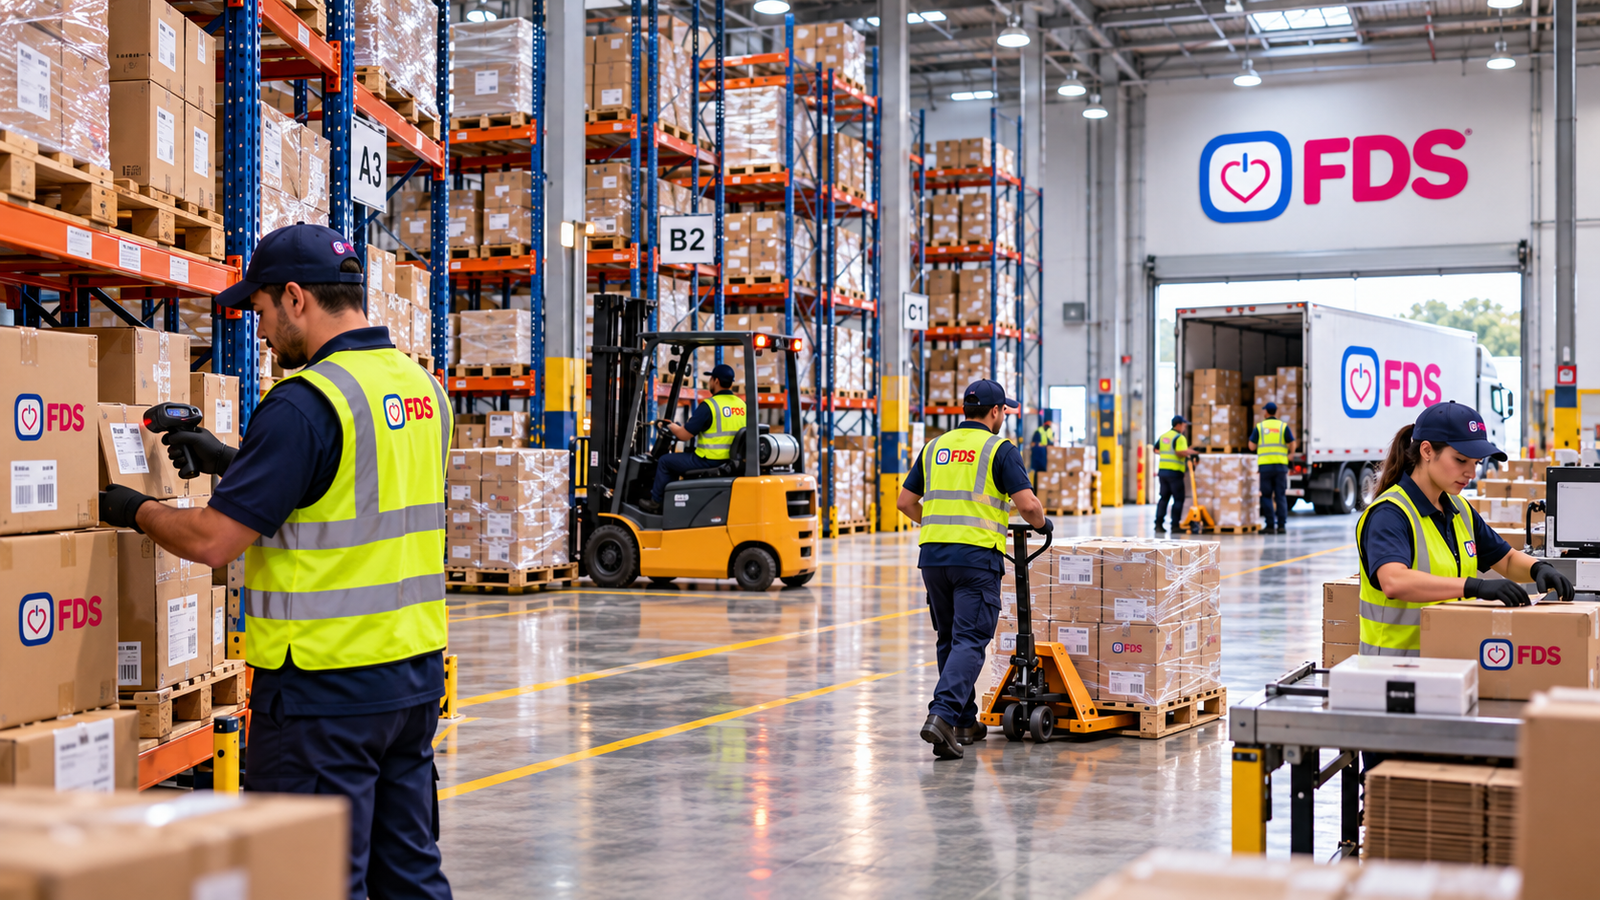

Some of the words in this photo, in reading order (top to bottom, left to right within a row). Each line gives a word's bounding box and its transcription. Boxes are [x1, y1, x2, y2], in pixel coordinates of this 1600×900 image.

[359, 146, 382, 188] A3
[1304, 128, 1469, 205] FDS
[670, 228, 705, 252] B2
[908, 304, 923, 321] C1
[1384, 359, 1442, 408] FDS
[47, 403, 85, 432] FDS
[404, 395, 434, 421] FDS
[950, 449, 976, 463] FDS
[58, 595, 103, 632] FDS
[1123, 643, 1143, 654] FDS
[1517, 645, 1562, 666] FDS
